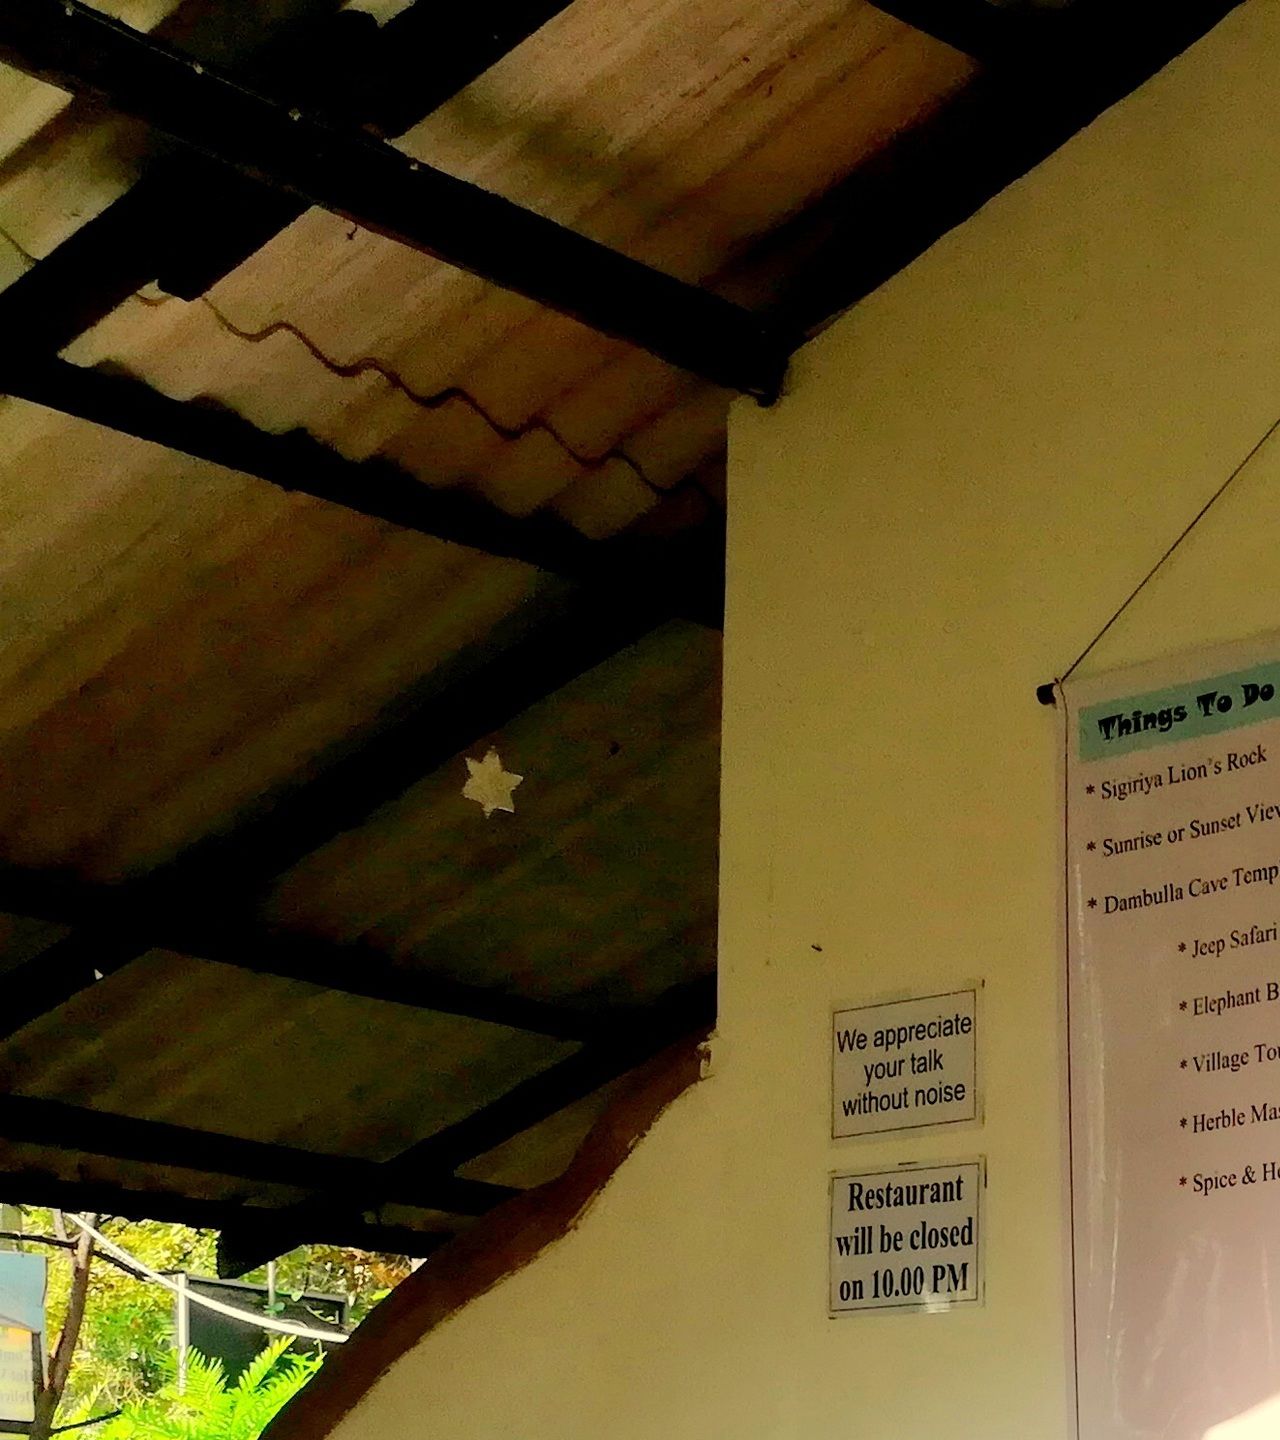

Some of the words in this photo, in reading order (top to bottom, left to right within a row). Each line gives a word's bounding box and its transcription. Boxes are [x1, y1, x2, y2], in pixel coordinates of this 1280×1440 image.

[1098, 704, 1188, 741] Things
[1198, 691, 1233, 717] To
[1242, 683, 1276, 708] Do
[1101, 773, 1163, 801] Sigiriya
[1227, 744, 1267, 770] Rock
[1103, 828, 1162, 857] Sunrise
[1167, 827, 1185, 845] or
[1189, 812, 1242, 841] Sunset
[1104, 884, 1184, 915] Dambulla
[1188, 873, 1229, 898] Cave
[1192, 937, 1226, 961] Jeep
[1230, 921, 1278, 950] Safari
[1192, 988, 1262, 1018] Elephant
[837, 1029, 867, 1053] We
[874, 1013, 972, 1052] appreciate
[864, 1059, 904, 1086] your
[911, 1049, 944, 1075] talk
[1192, 1048, 1249, 1074] Village
[842, 1088, 909, 1116] without
[915, 1082, 966, 1107] noise
[1192, 1107, 1246, 1134] Herble
[848, 1174, 964, 1211] Restaurant
[1192, 1170, 1237, 1195] Spice
[1242, 1165, 1258, 1184] &
[836, 1227, 873, 1256] will
[880, 1224, 903, 1253] be
[910, 1217, 974, 1249] closed
[840, 1278, 864, 1301] on
[872, 1266, 925, 1298] 10.00
[932, 1263, 969, 1293] PM
